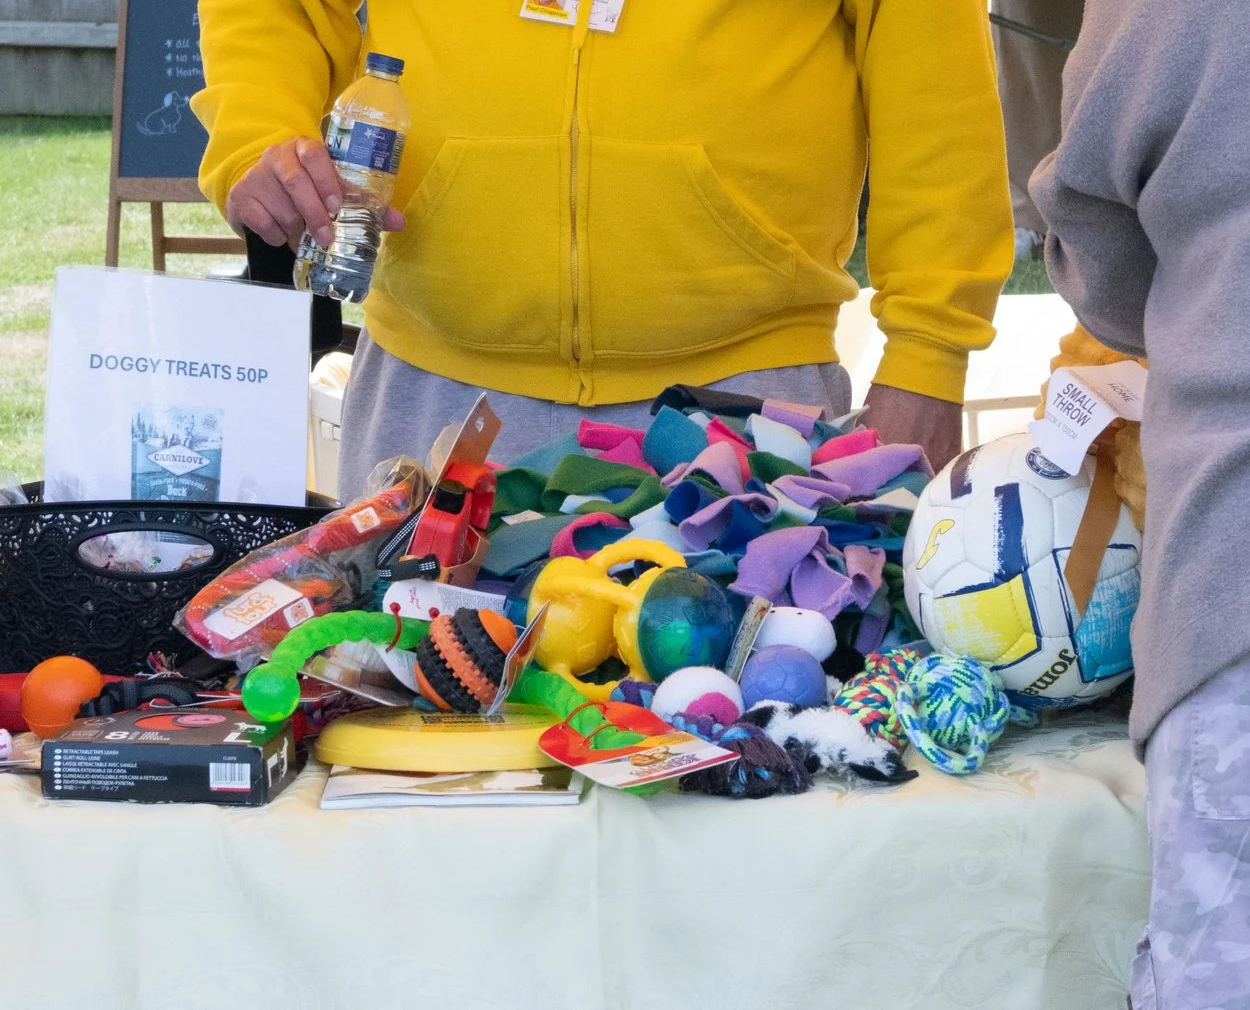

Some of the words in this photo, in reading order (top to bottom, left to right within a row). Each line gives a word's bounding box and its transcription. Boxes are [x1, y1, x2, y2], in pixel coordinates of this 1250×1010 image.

[526, 4, 539, 12] Paul
[540, 7, 567, 18] Chapman
[89, 353, 161, 373] DOGGY
[165, 359, 232, 380] TREATS
[236, 366, 268, 383] 50P
[1062, 383, 1097, 415] SMALL
[1107, 382, 1134, 403] HOME
[1052, 393, 1091, 427] THROW
[154, 453, 204, 465] CARNILOVE
[167, 484, 187, 497] Duck
[1020, 649, 1079, 696] Joma
[104, 731, 129, 740] 8
[223, 732, 251, 742] L
